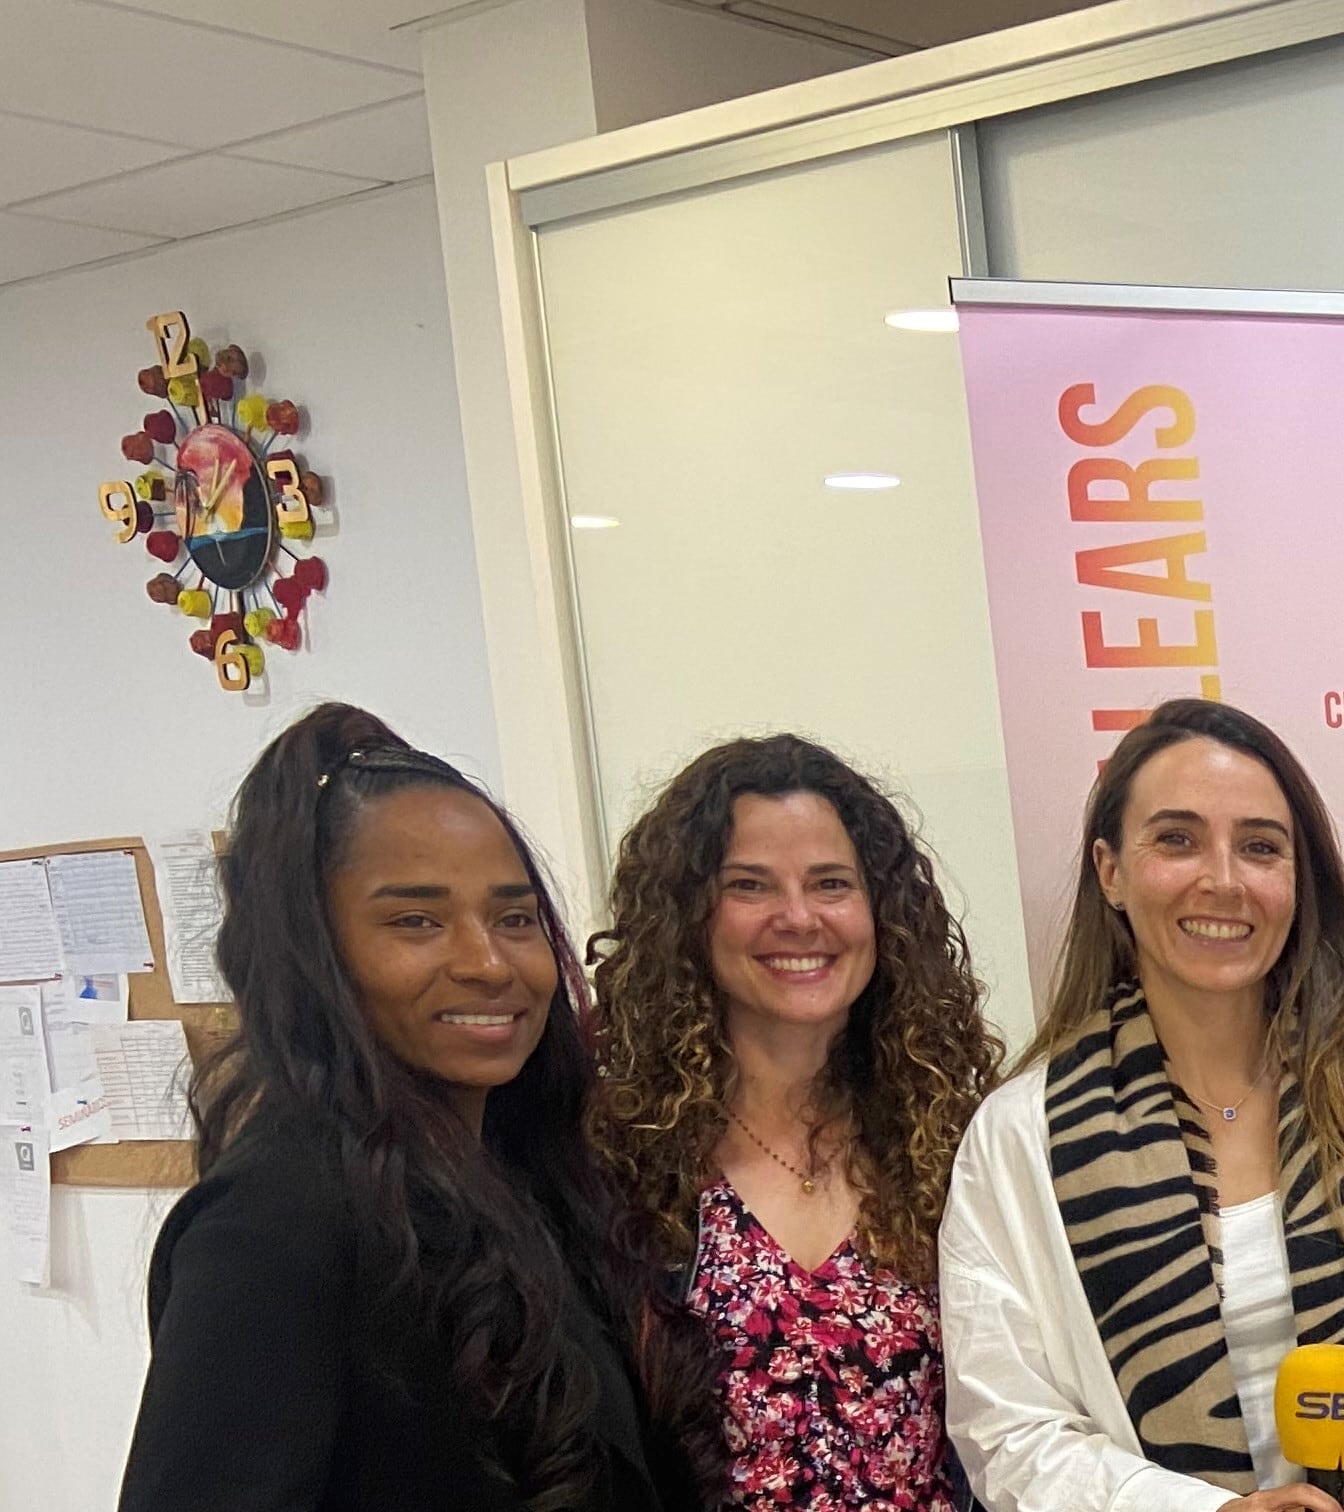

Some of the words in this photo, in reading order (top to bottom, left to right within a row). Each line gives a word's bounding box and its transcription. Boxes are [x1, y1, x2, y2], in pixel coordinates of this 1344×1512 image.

[100, 480, 138, 543] 9
[266, 458, 312, 523] 3
[215, 630, 251, 691] 6
